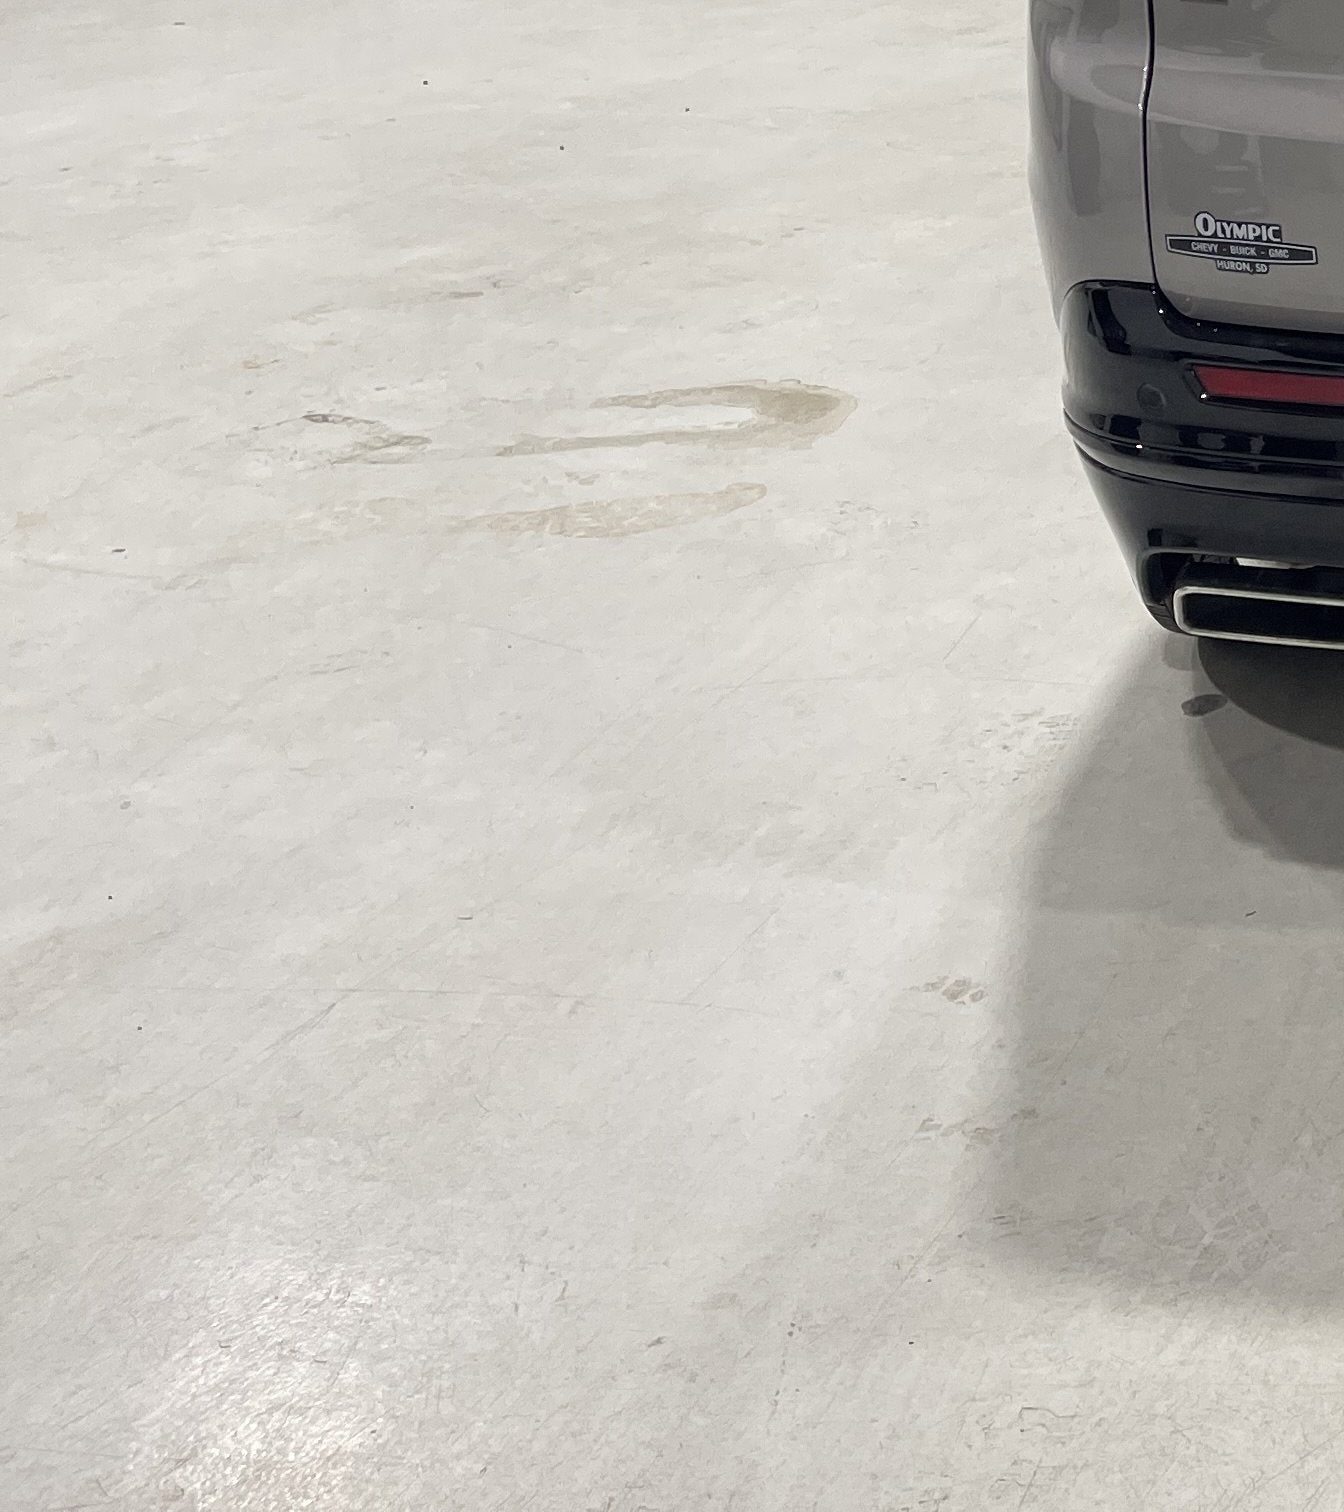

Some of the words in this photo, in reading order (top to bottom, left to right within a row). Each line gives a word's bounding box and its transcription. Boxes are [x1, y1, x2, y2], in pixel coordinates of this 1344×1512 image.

[1195, 212, 1281, 242] OLYMPIC
[1191, 241, 1218, 253] CHEVY
[1230, 245, 1257, 257] BUICK
[1269, 248, 1290, 259] GMC
[1256, 263, 1268, 273] SD
